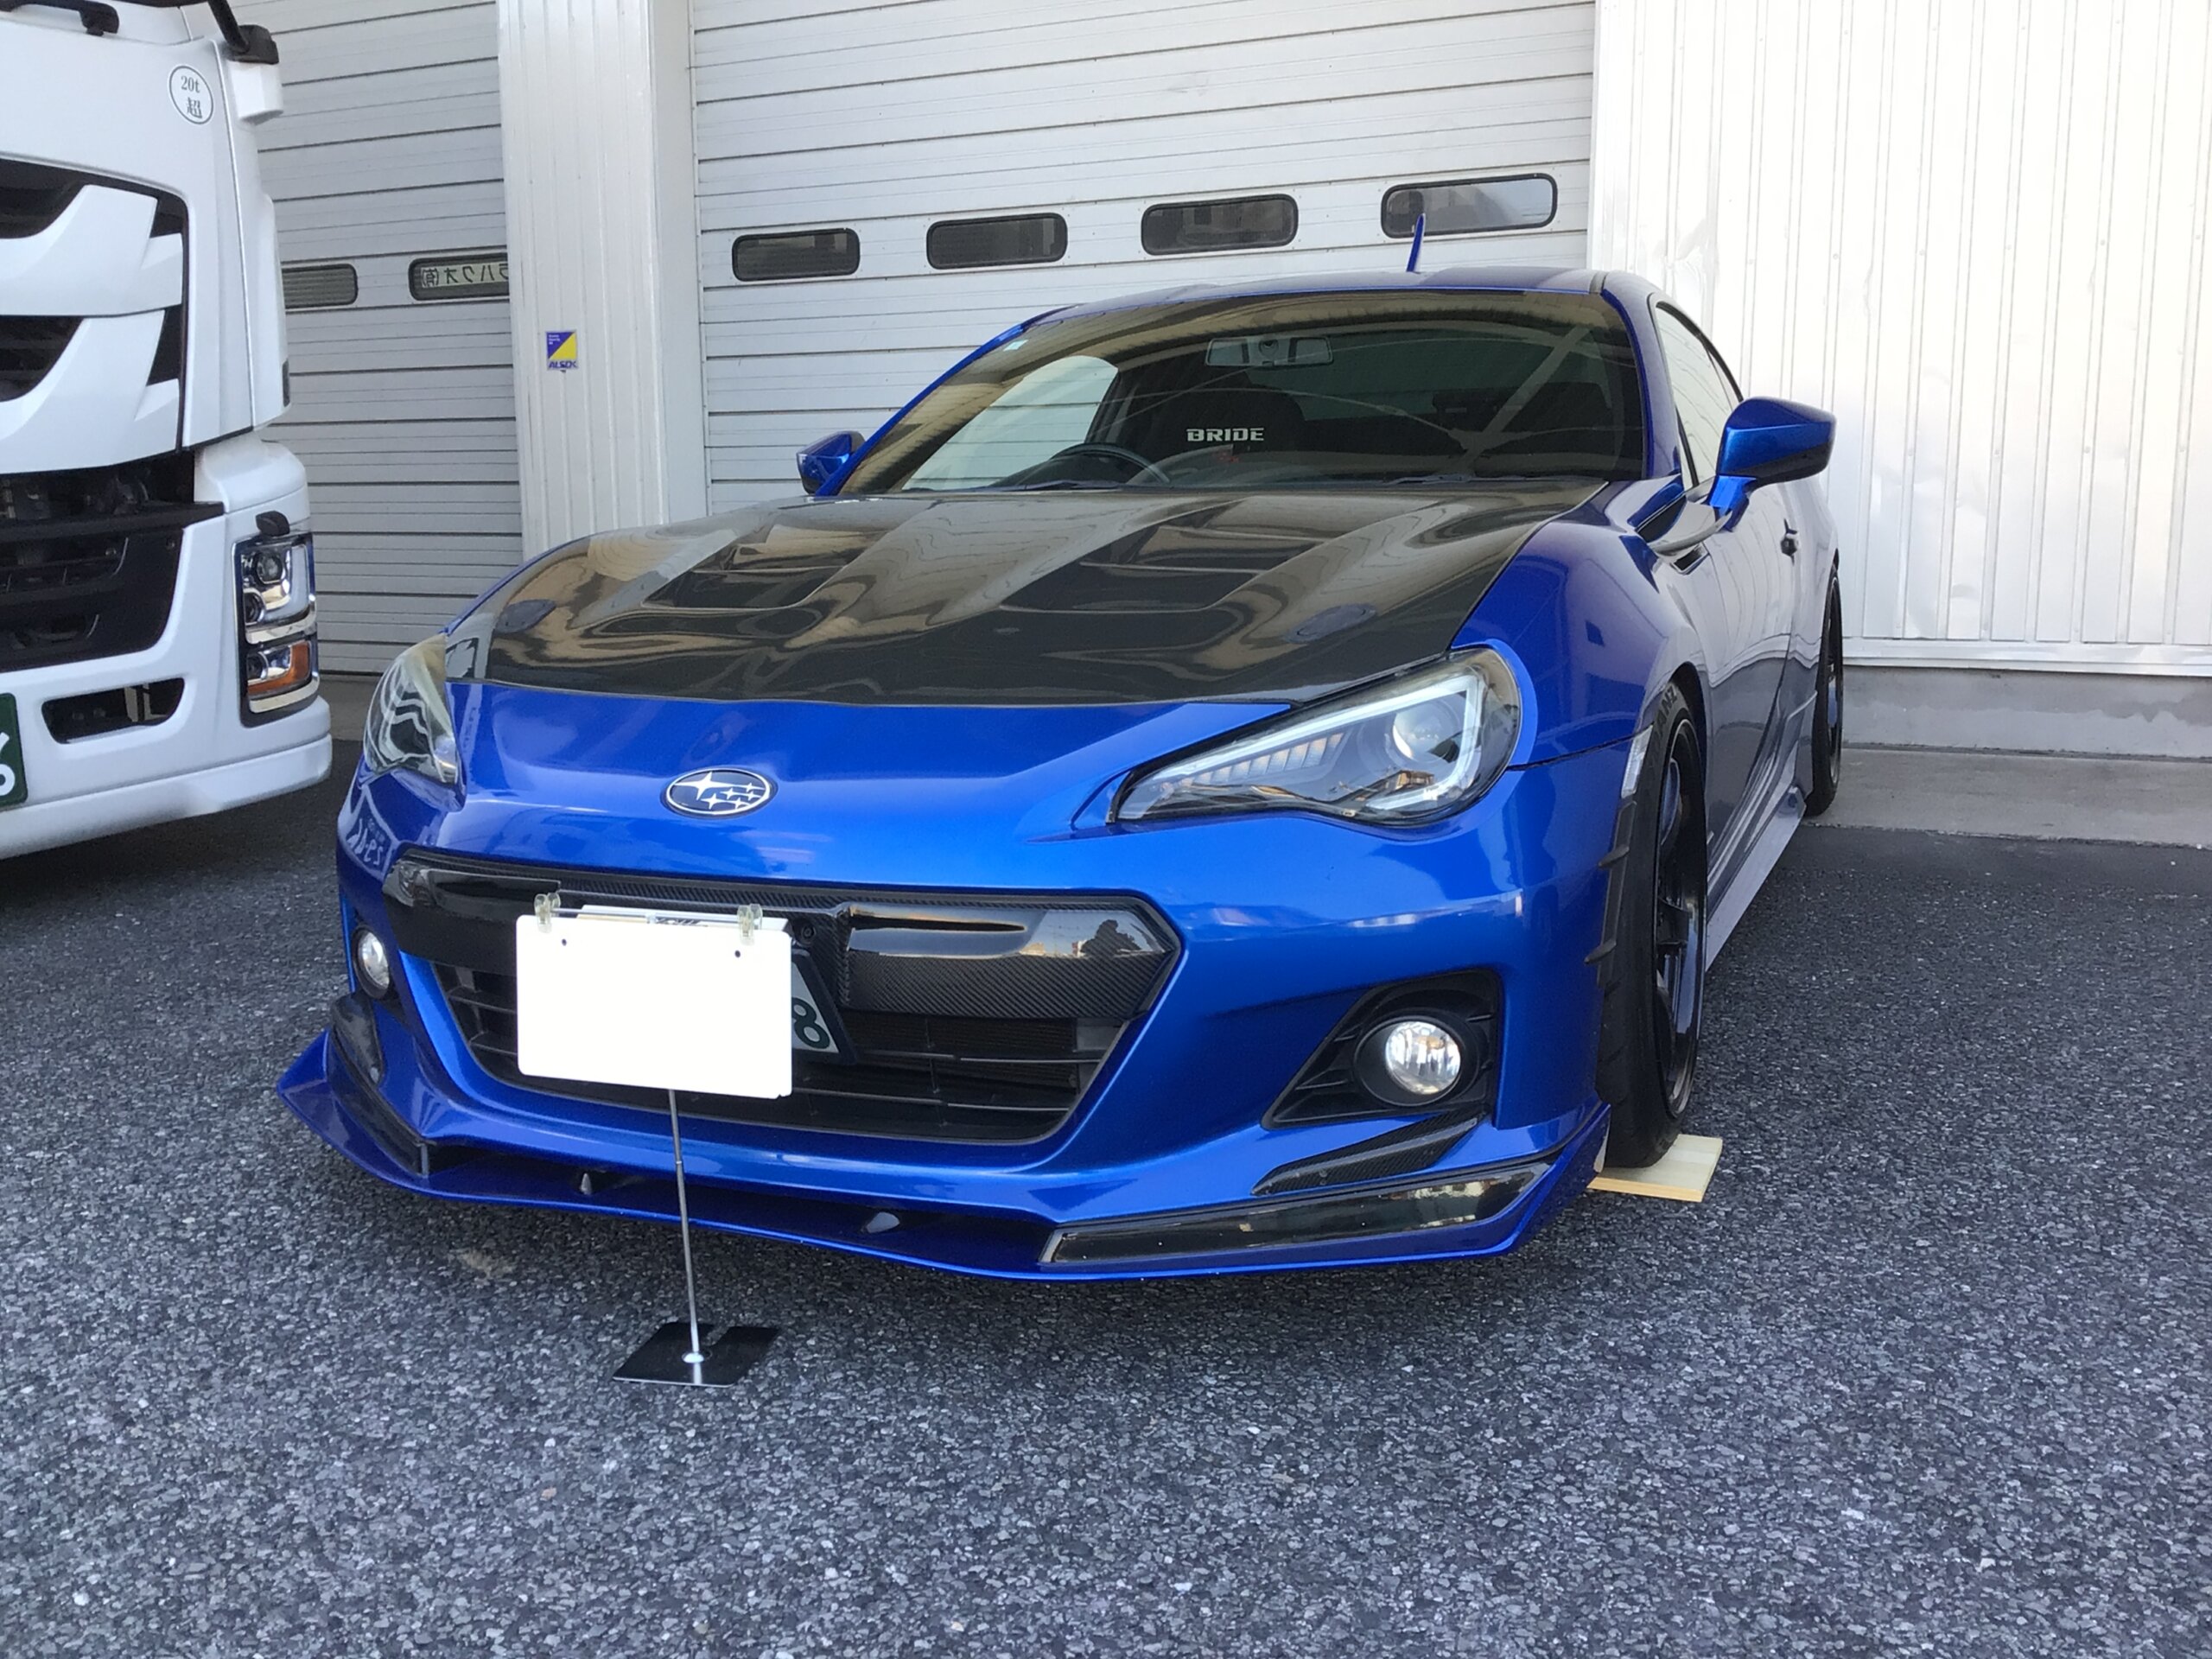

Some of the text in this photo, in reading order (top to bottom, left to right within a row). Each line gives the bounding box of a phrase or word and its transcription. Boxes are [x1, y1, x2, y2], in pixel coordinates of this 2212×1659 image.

[181, 75, 200, 93] 20t
[187, 97, 202, 118] 超
[1186, 428, 1264, 442] BRIDE
